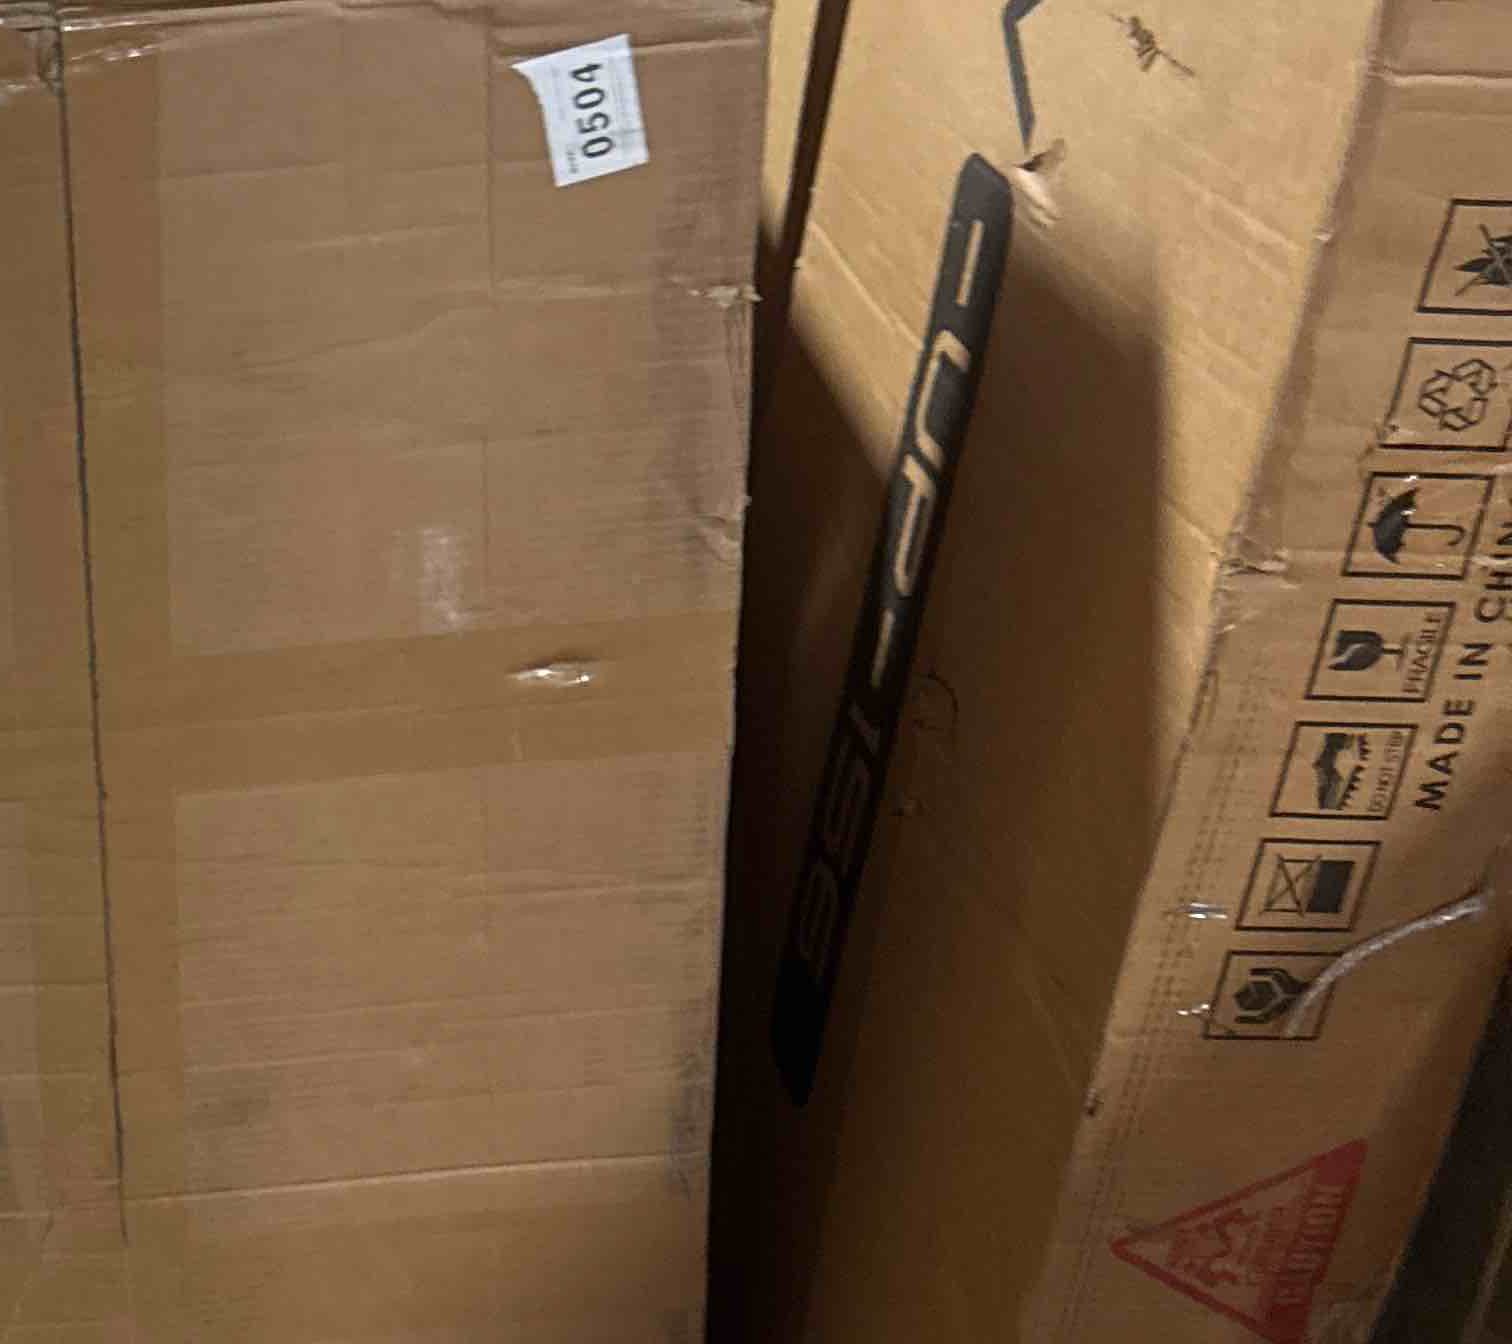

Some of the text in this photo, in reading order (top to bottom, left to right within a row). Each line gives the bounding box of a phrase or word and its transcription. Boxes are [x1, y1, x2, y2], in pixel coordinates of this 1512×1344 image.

[571, 63, 615, 159] 0504
[1402, 611, 1442, 694] FRAGILE
[1414, 500, 1512, 814] MADE IN CHIN
